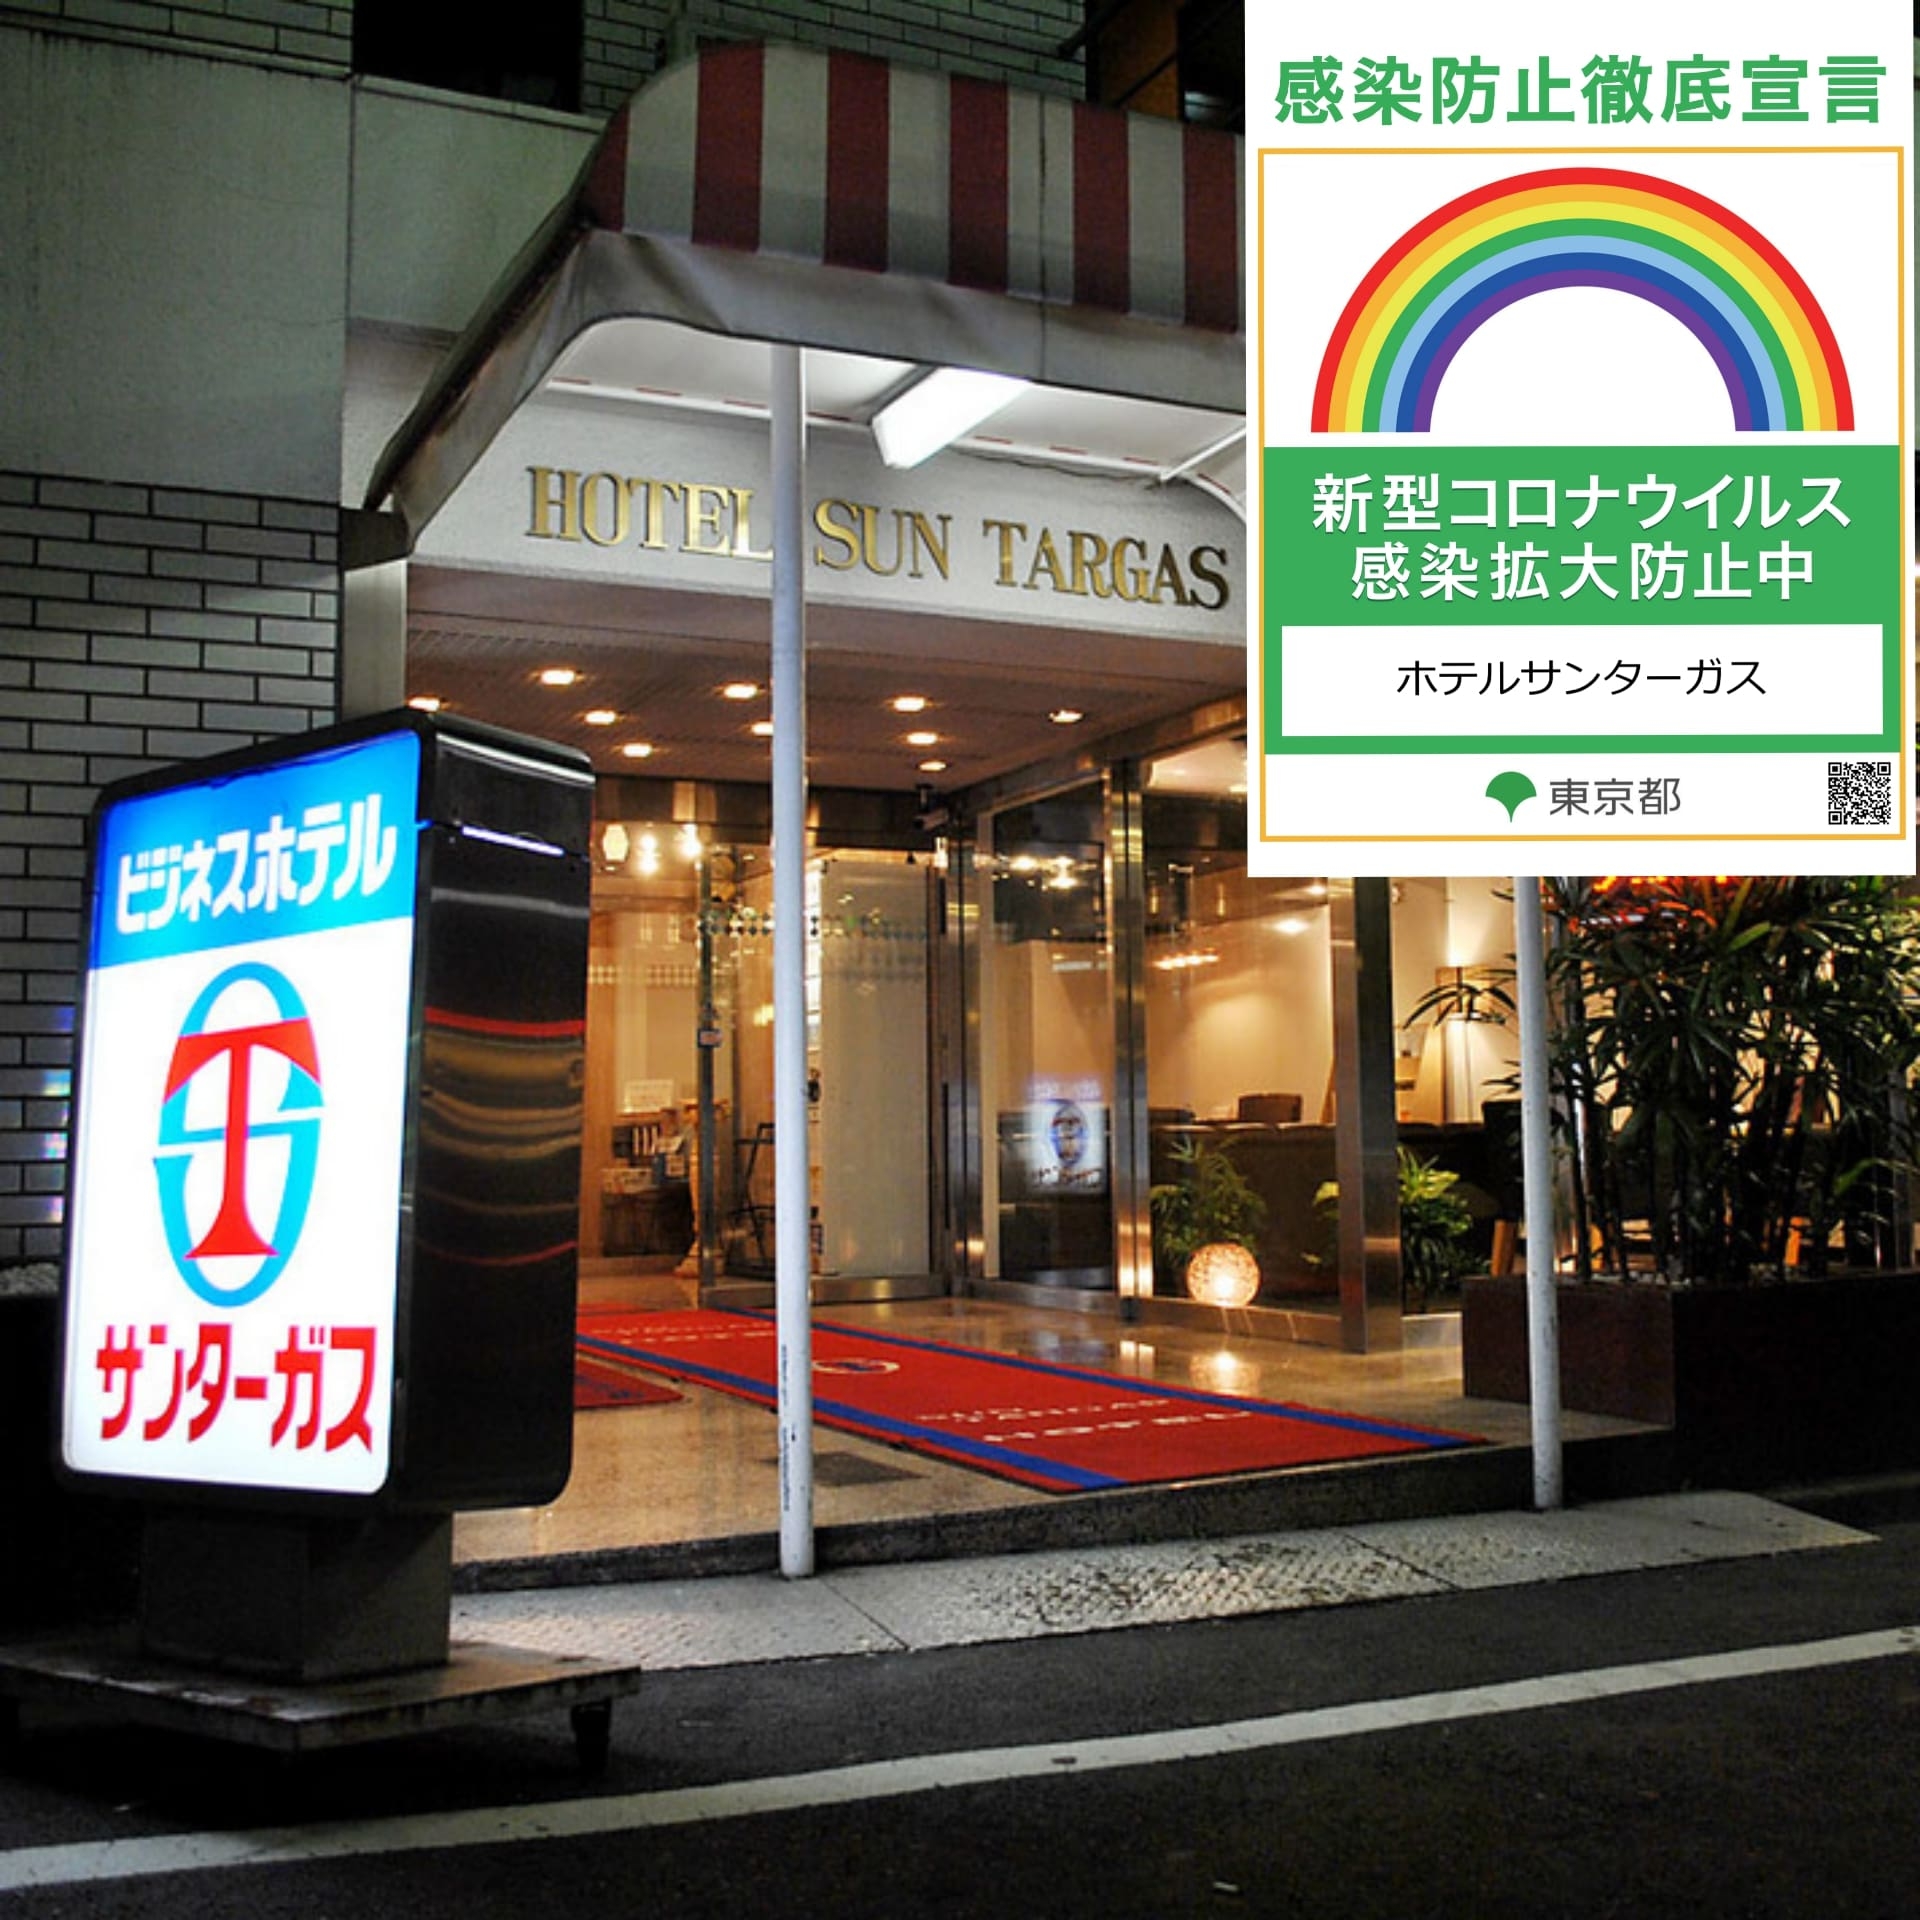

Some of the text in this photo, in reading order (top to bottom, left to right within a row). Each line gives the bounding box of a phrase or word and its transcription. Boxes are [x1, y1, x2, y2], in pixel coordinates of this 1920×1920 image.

[525, 466, 1230, 610] HOTEL SUN TARGAS
[116, 793, 398, 936] ビジネスホテル
[96, 1323, 376, 1453] サンターガス
